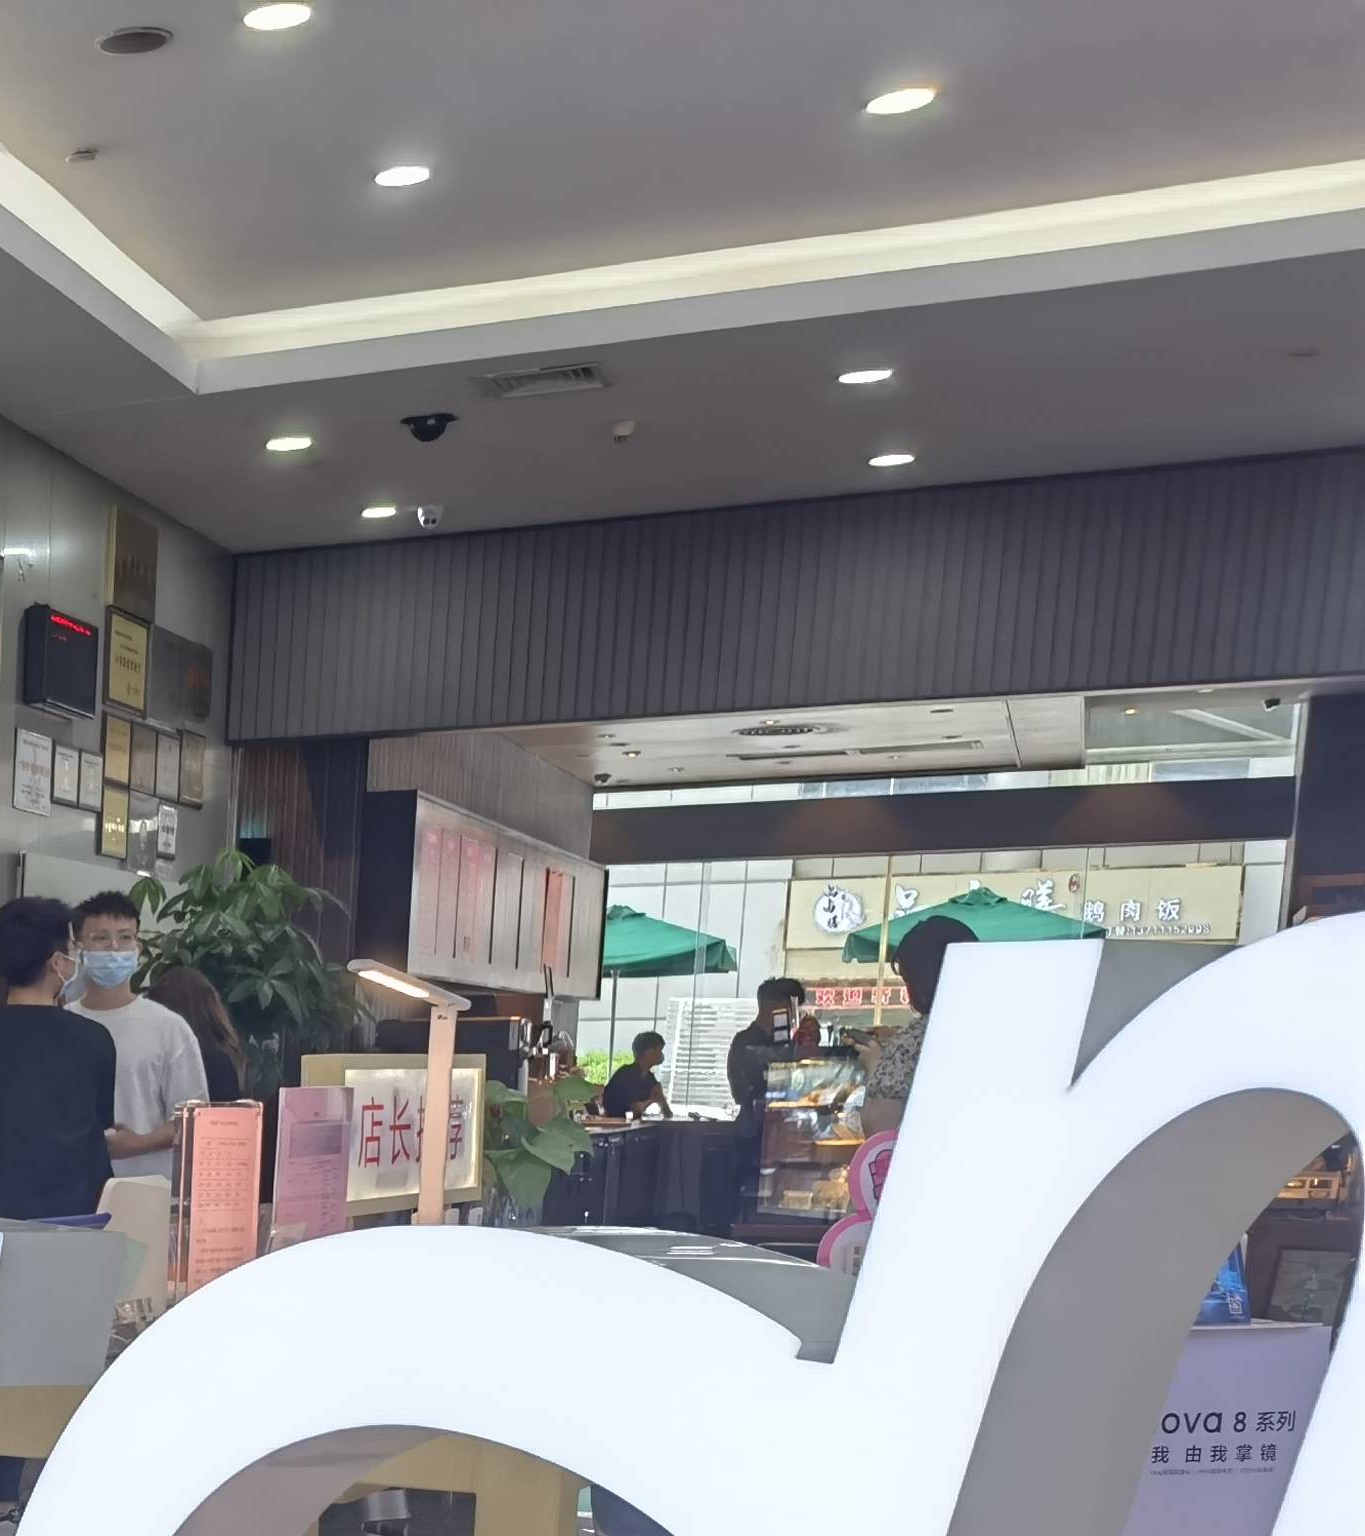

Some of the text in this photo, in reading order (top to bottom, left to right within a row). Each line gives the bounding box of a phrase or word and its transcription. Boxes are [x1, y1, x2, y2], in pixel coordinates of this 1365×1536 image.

[1161, 1410, 1297, 1434] ova 8 系列
[1151, 1443, 1277, 1464] 我 由我掌镜
